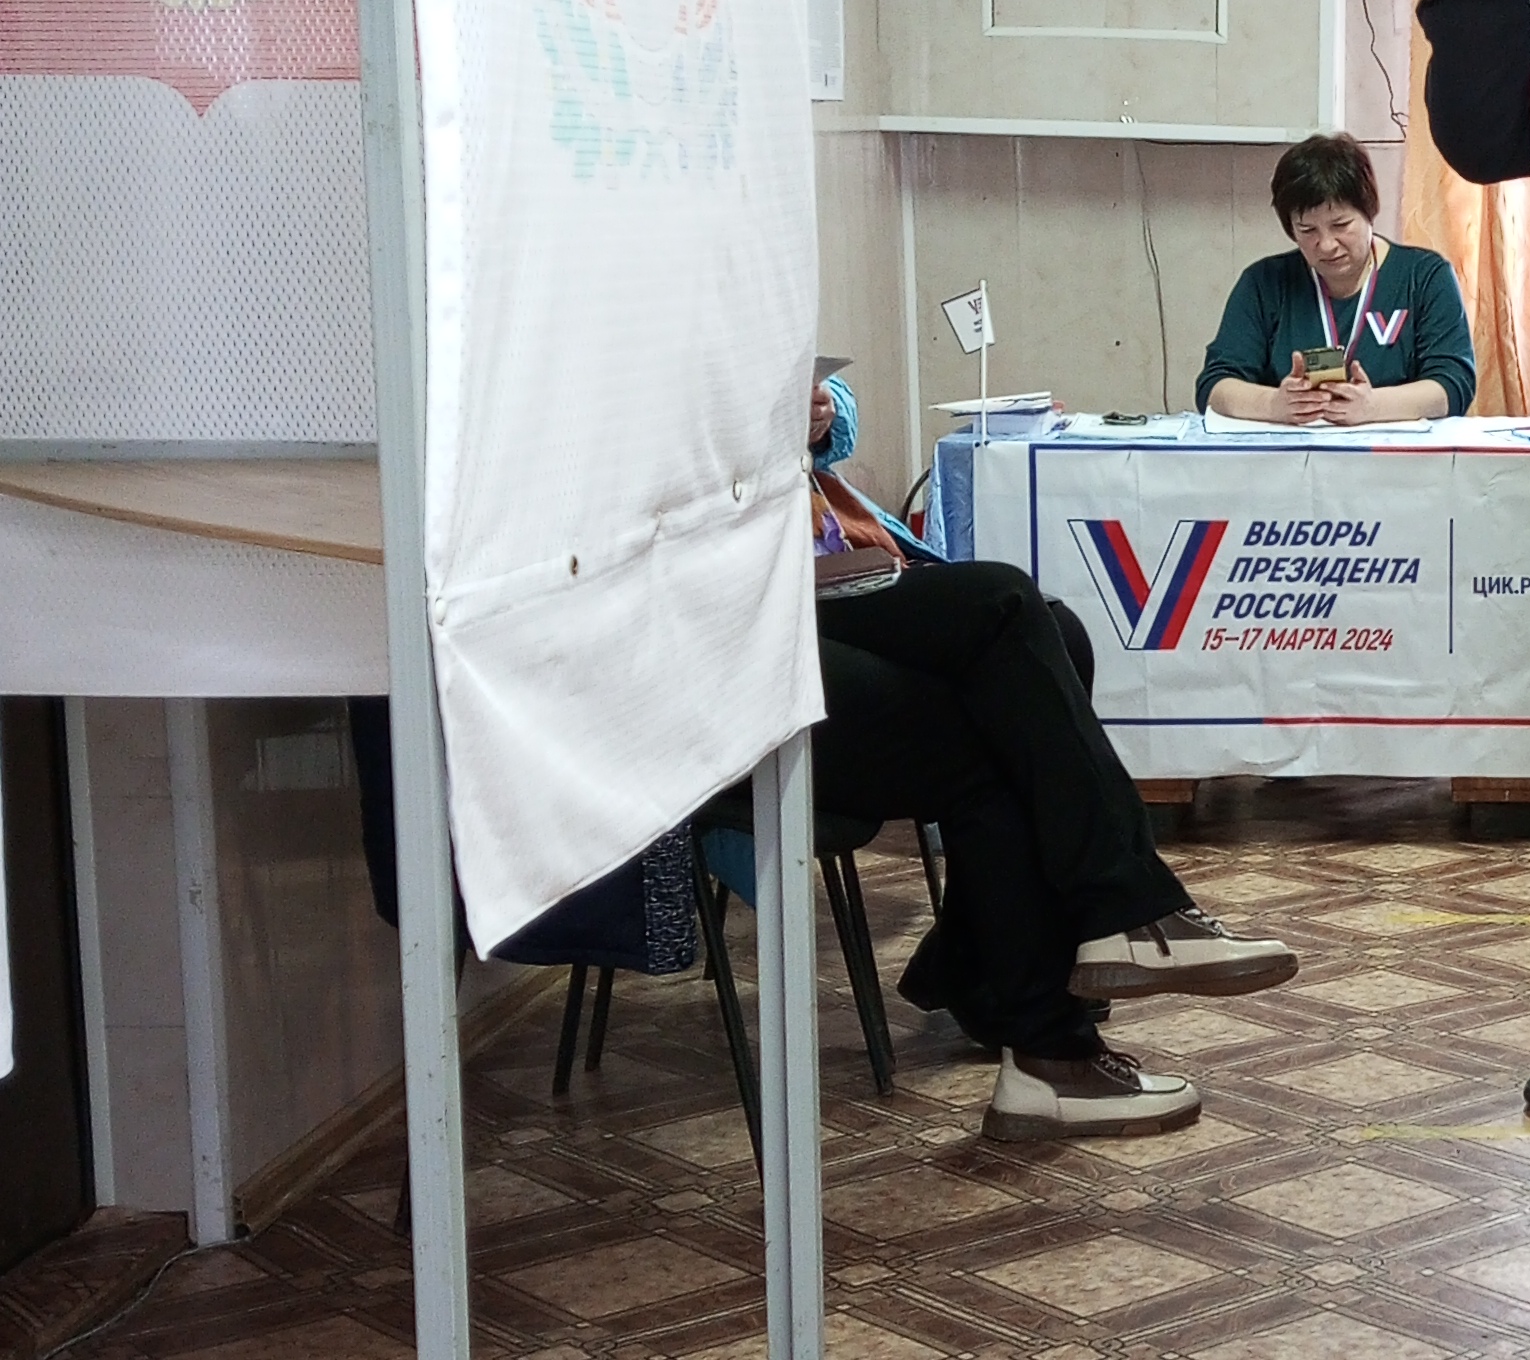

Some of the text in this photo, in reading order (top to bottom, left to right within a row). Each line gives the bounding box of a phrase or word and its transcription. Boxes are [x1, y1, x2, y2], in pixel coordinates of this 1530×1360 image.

[1243, 521, 1381, 547] ВЫБОРЫ
[1227, 557, 1421, 587] ПРЕЗИДЕНТА
[1212, 593, 1338, 619] РОССИИ
[1262, 628, 1338, 651] МАРТА
[1340, 628, 1394, 652] 2024
